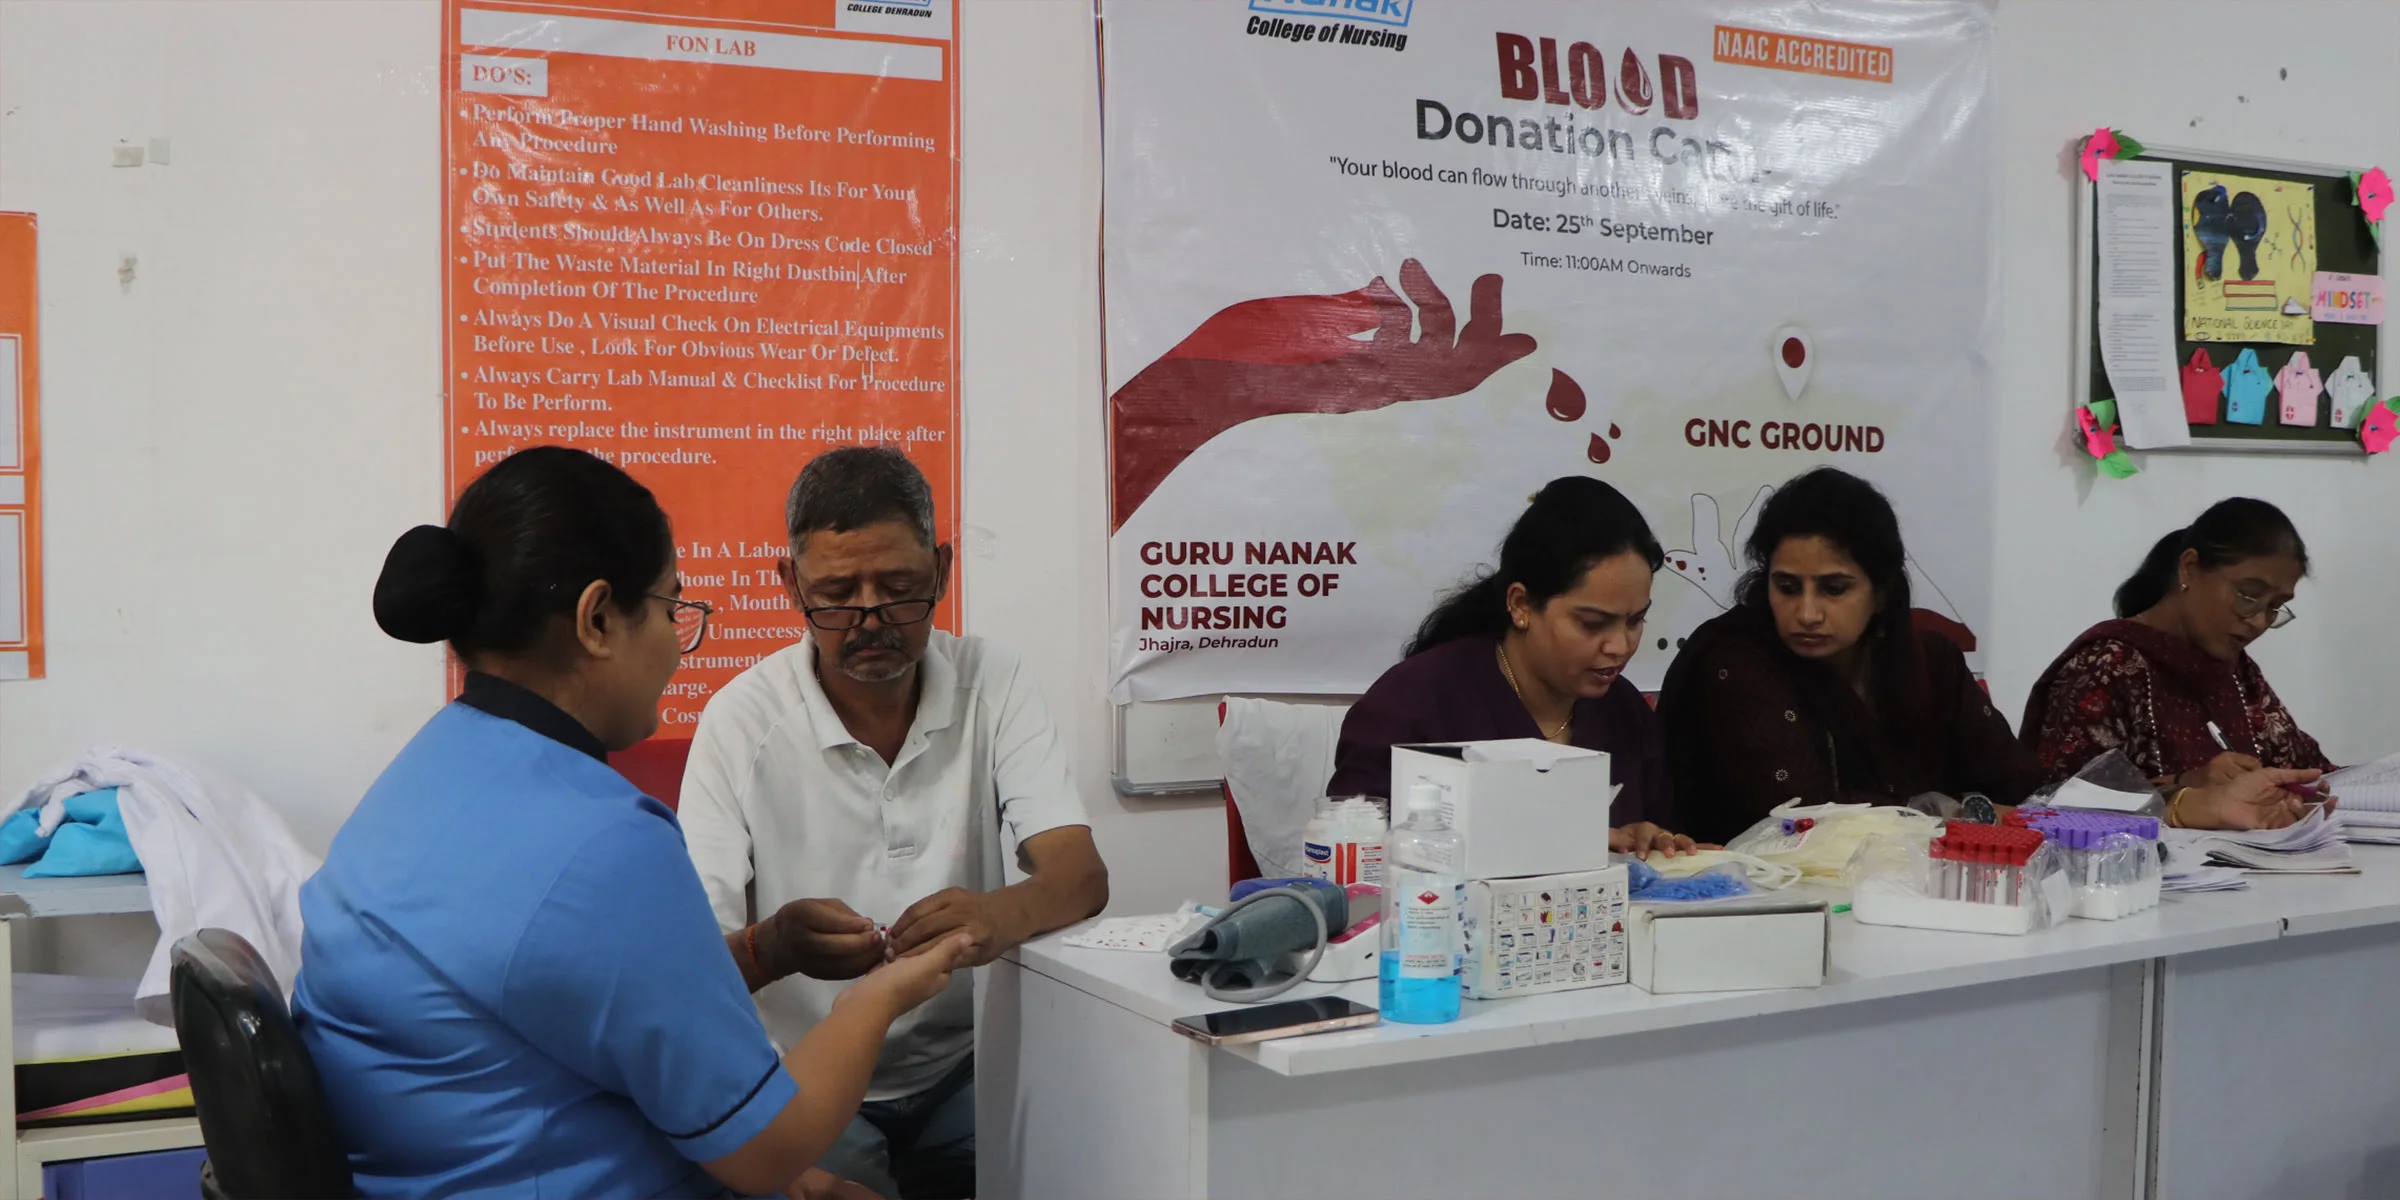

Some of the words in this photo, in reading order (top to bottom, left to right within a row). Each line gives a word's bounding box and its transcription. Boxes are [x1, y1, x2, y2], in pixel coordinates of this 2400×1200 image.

[847, 4, 882, 14] COLLEGE
[885, 6, 932, 18] DEHRADUN
[666, 33, 708, 53] FON
[715, 37, 756, 57] LAB
[1247, 15, 1316, 42] College
[1318, 23, 1340, 43] of
[1339, 24, 1408, 52] Nursing
[1717, 30, 1769, 61] NAAC
[1776, 38, 1890, 77] ACCREDITED
[473, 104, 553, 125] Perform
[560, 109, 625, 131] Proper
[632, 113, 682, 133] Hand
[690, 118, 767, 143] Washing
[773, 123, 831, 142] Before
[837, 127, 935, 152] Performing
[1416, 98, 1634, 160] Donation
[473, 132, 513, 152] Any
[520, 132, 617, 155] Procedure
[473, 161, 500, 179] Do
[508, 163, 595, 184] Maintain
[601, 168, 651, 187] Good
[659, 171, 694, 188] Lab
[701, 174, 804, 196] Cleanliness
[809, 180, 831, 197] Its
[837, 181, 868, 199] For
[872, 184, 915, 201] Your
[1330, 156, 1377, 176] "Your
[1383, 160, 1434, 181] blood
[1438, 169, 1467, 184] can
[1472, 167, 1507, 188] flow
[1512, 173, 1576, 198] through
[1771, 199, 1793, 217] gift
[1796, 201, 1811, 217] of
[472, 187, 519, 206] Own
[525, 190, 585, 213] Safety
[592, 195, 608, 211] &
[615, 195, 638, 212] As
[644, 195, 685, 214] Well
[691, 199, 713, 216] As
[719, 200, 752, 217] For
[758, 202, 823, 222] Others.
[473, 215, 558, 240] Students
[563, 222, 629, 242] Should
[637, 227, 702, 249] Always
[708, 230, 731, 247] Be
[737, 231, 765, 249] On
[771, 233, 819, 251] Dress
[825, 235, 870, 253] Code
[876, 237, 933, 256] Closed
[1493, 208, 1551, 231] Date:
[1556, 213, 1593, 235] 25th
[1600, 218, 1714, 245] September
[473, 251, 506, 268] Put
[514, 252, 550, 270] The
[556, 254, 613, 272] Waste
[620, 256, 699, 276] Material
[707, 260, 725, 276] In
[733, 261, 781, 282] Right
[788, 264, 856, 282] Dustbin
[860, 267, 907, 284] After
[1521, 252, 1562, 268] Time:
[1566, 254, 1623, 273] 11:00AM
[1627, 260, 1692, 278] Onwards
[473, 277, 586, 300] Completion
[592, 281, 618, 298] Of
[622, 283, 659, 300] The
[665, 284, 758, 303] Procedure
[474, 309, 542, 331] Always
[548, 311, 574, 328] Do
[578, 312, 592, 328] A
[599, 313, 656, 331] Visual
[662, 314, 717, 332] Check
[724, 317, 750, 334] On
[757, 318, 839, 336] Electrical
[845, 321, 945, 341] Equipments
[474, 336, 535, 353] Before
[541, 337, 575, 354] Use
[592, 338, 638, 356] Look
[644, 339, 676, 356] For
[682, 341, 754, 359] Obvious
[759, 342, 806, 360] Wear
[812, 343, 836, 361] Or
[842, 345, 899, 362] Defect.
[474, 366, 541, 388] Always
[546, 368, 601, 389] Carry
[607, 369, 642, 386] Lab
[648, 369, 716, 388] Manual
[721, 371, 737, 388] &
[743, 371, 823, 390] Checklist
[829, 374, 857, 390] For
[862, 375, 945, 392] Procedure
[474, 392, 498, 410] To
[503, 393, 528, 410] Be
[532, 393, 613, 412] Perform.
[475, 420, 542, 441] Always
[548, 421, 615, 442] replace
[620, 421, 649, 438] the
[654, 422, 751, 441] instrument
[757, 424, 774, 440] in
[779, 424, 807, 440] the
[812, 425, 853, 444] right
[858, 425, 902, 445] place
[907, 426, 946, 442] after
[1684, 418, 1752, 449] GNC
[1760, 421, 1885, 453] GROUND
[587, 447, 615, 464] he
[620, 448, 716, 467] procedure.
[692, 542, 712, 558] In
[717, 542, 732, 558] A
[1140, 541, 1234, 566] GURU
[1245, 541, 1357, 565] NANAK
[677, 571, 725, 587] hone
[731, 570, 751, 586] In
[756, 570, 782, 586] Th
[1140, 573, 1288, 598] COLLEGE
[1297, 573, 1339, 597] OF
[729, 594, 791, 611] Mouth
[1141, 605, 1287, 630] NURSING
[1139, 636, 1194, 653] Jhajra,
[1198, 635, 1278, 649] Dehradun
